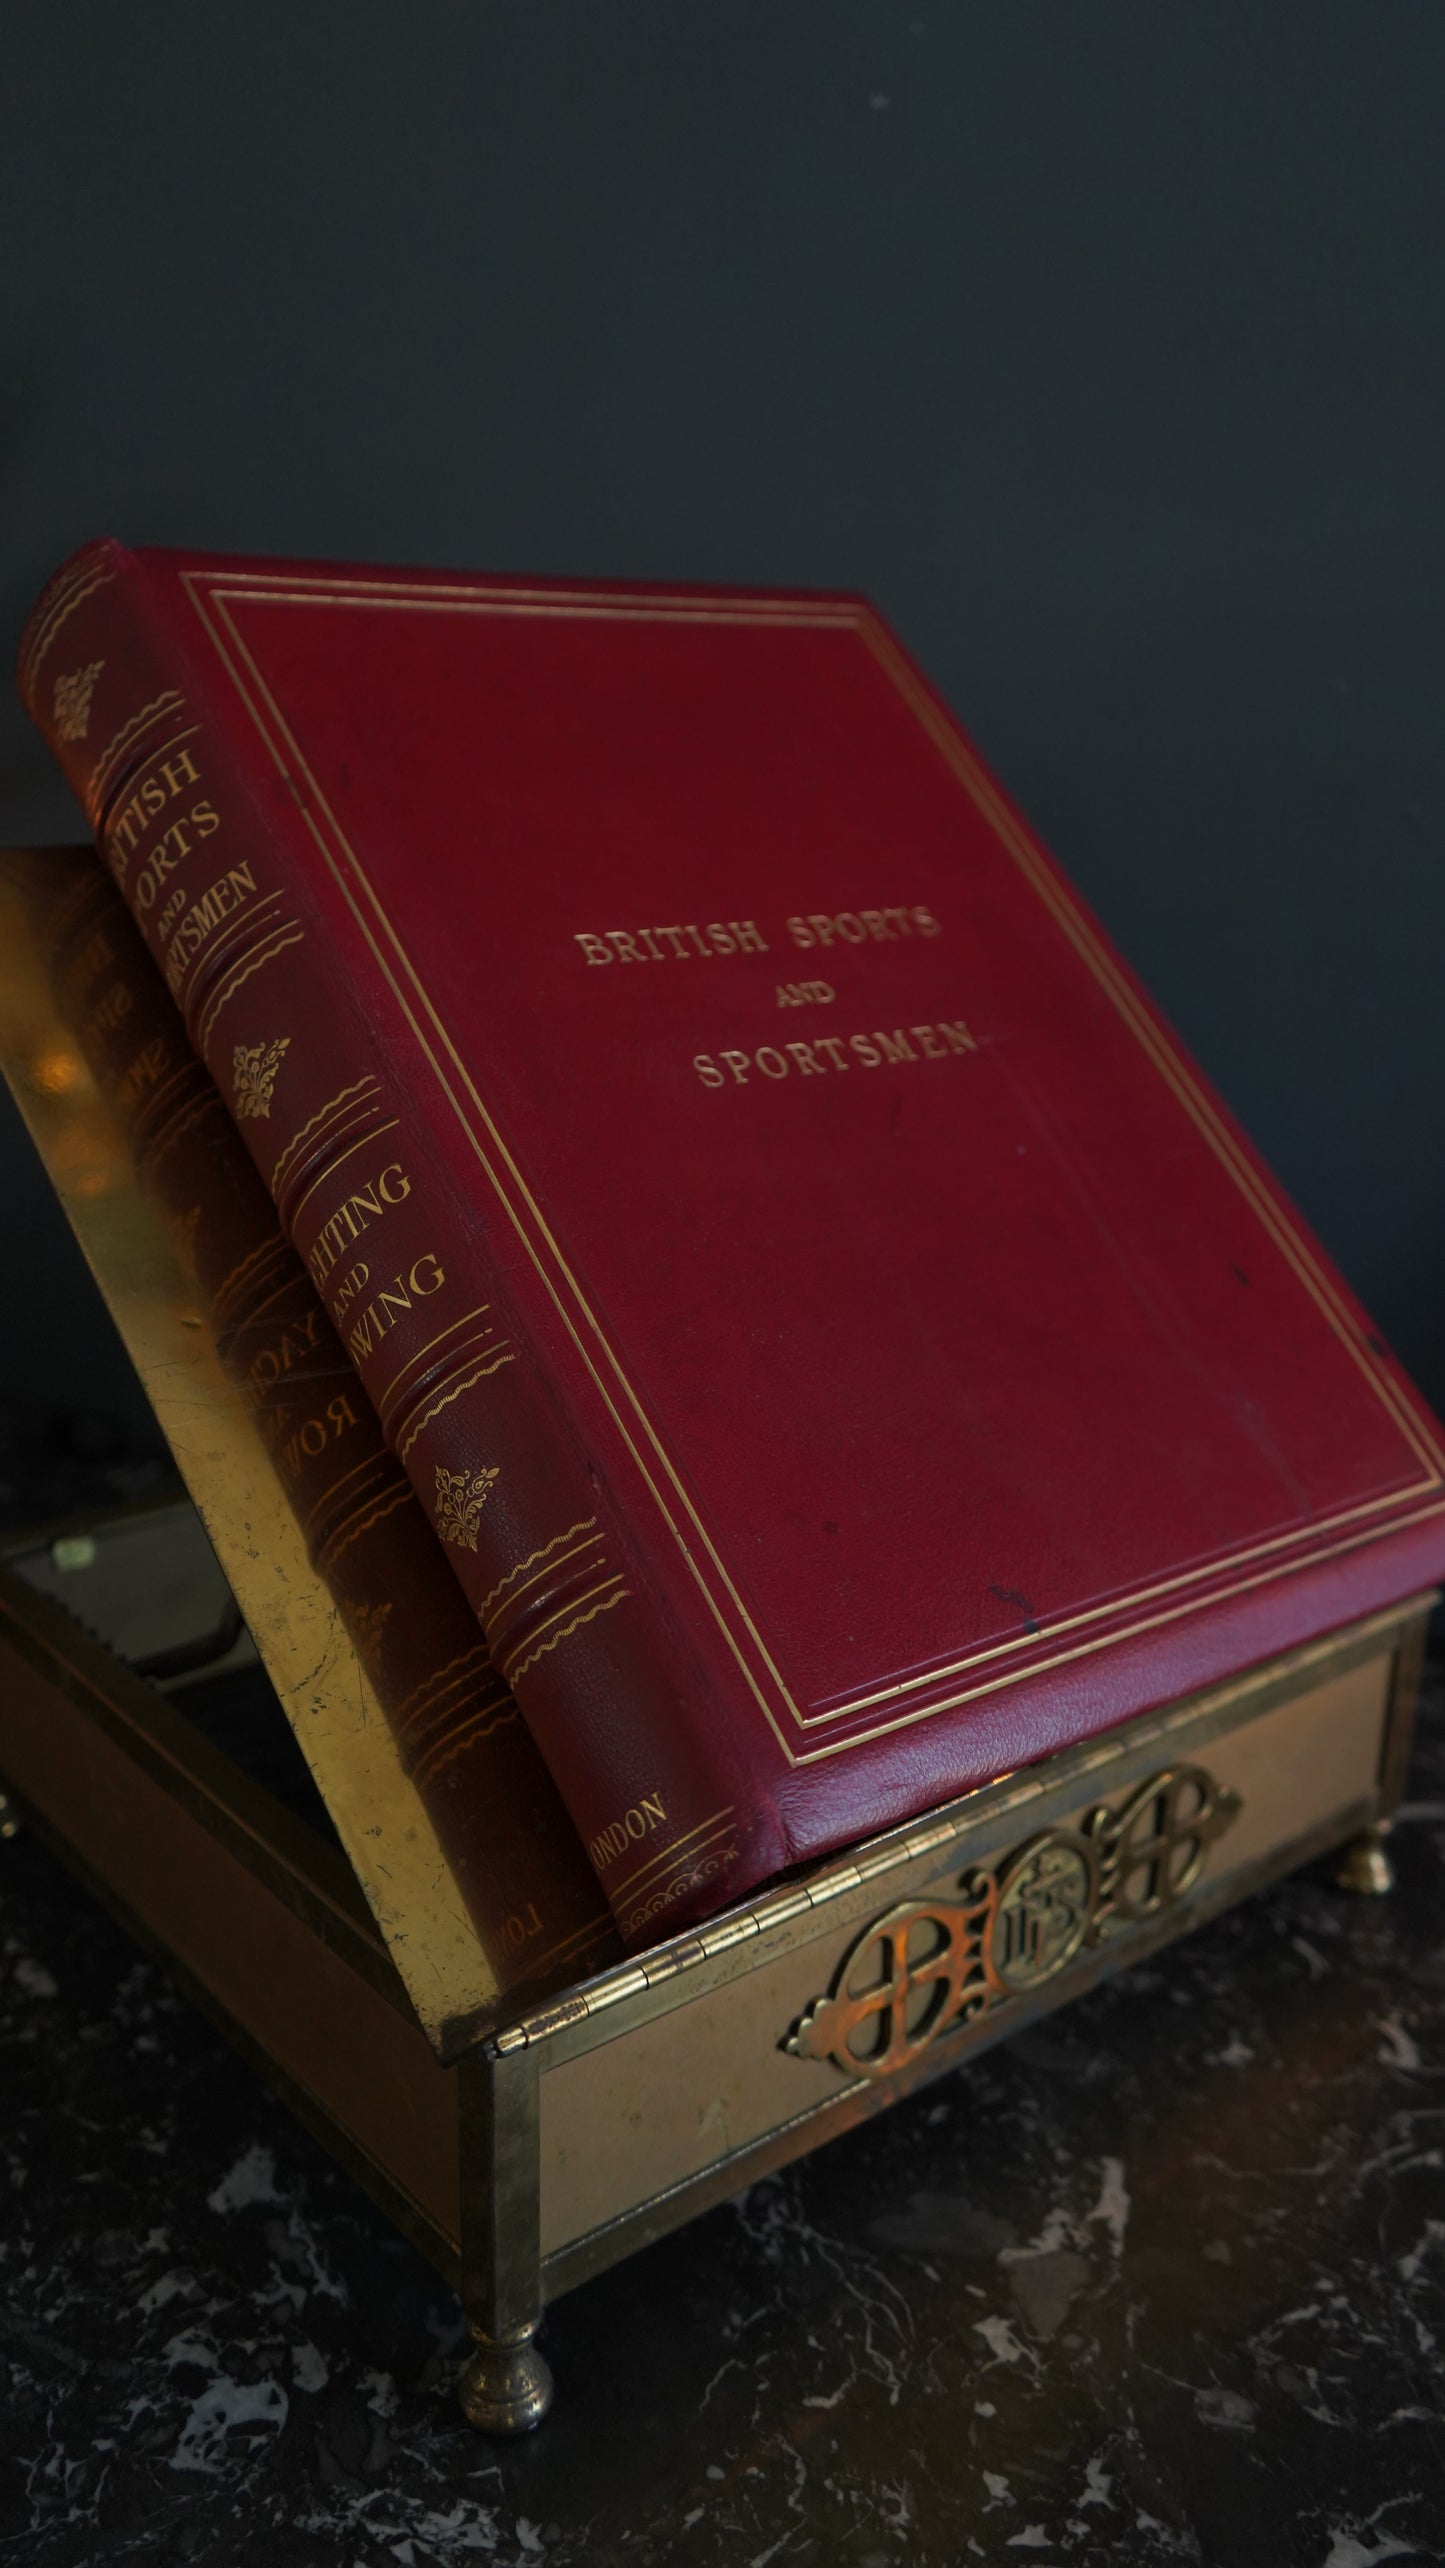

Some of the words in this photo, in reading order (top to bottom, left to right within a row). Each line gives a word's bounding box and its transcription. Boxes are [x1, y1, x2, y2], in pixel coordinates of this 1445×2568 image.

[134, 800, 220, 916] ORTS
[158, 889, 187, 943] AND
[574, 920, 769, 966] BRITISH
[786, 905, 943, 949] SPORTS
[775, 980, 836, 1008] AND
[692, 1020, 979, 1088] SPORTSMEN
[332, 1262, 370, 1328] AND
